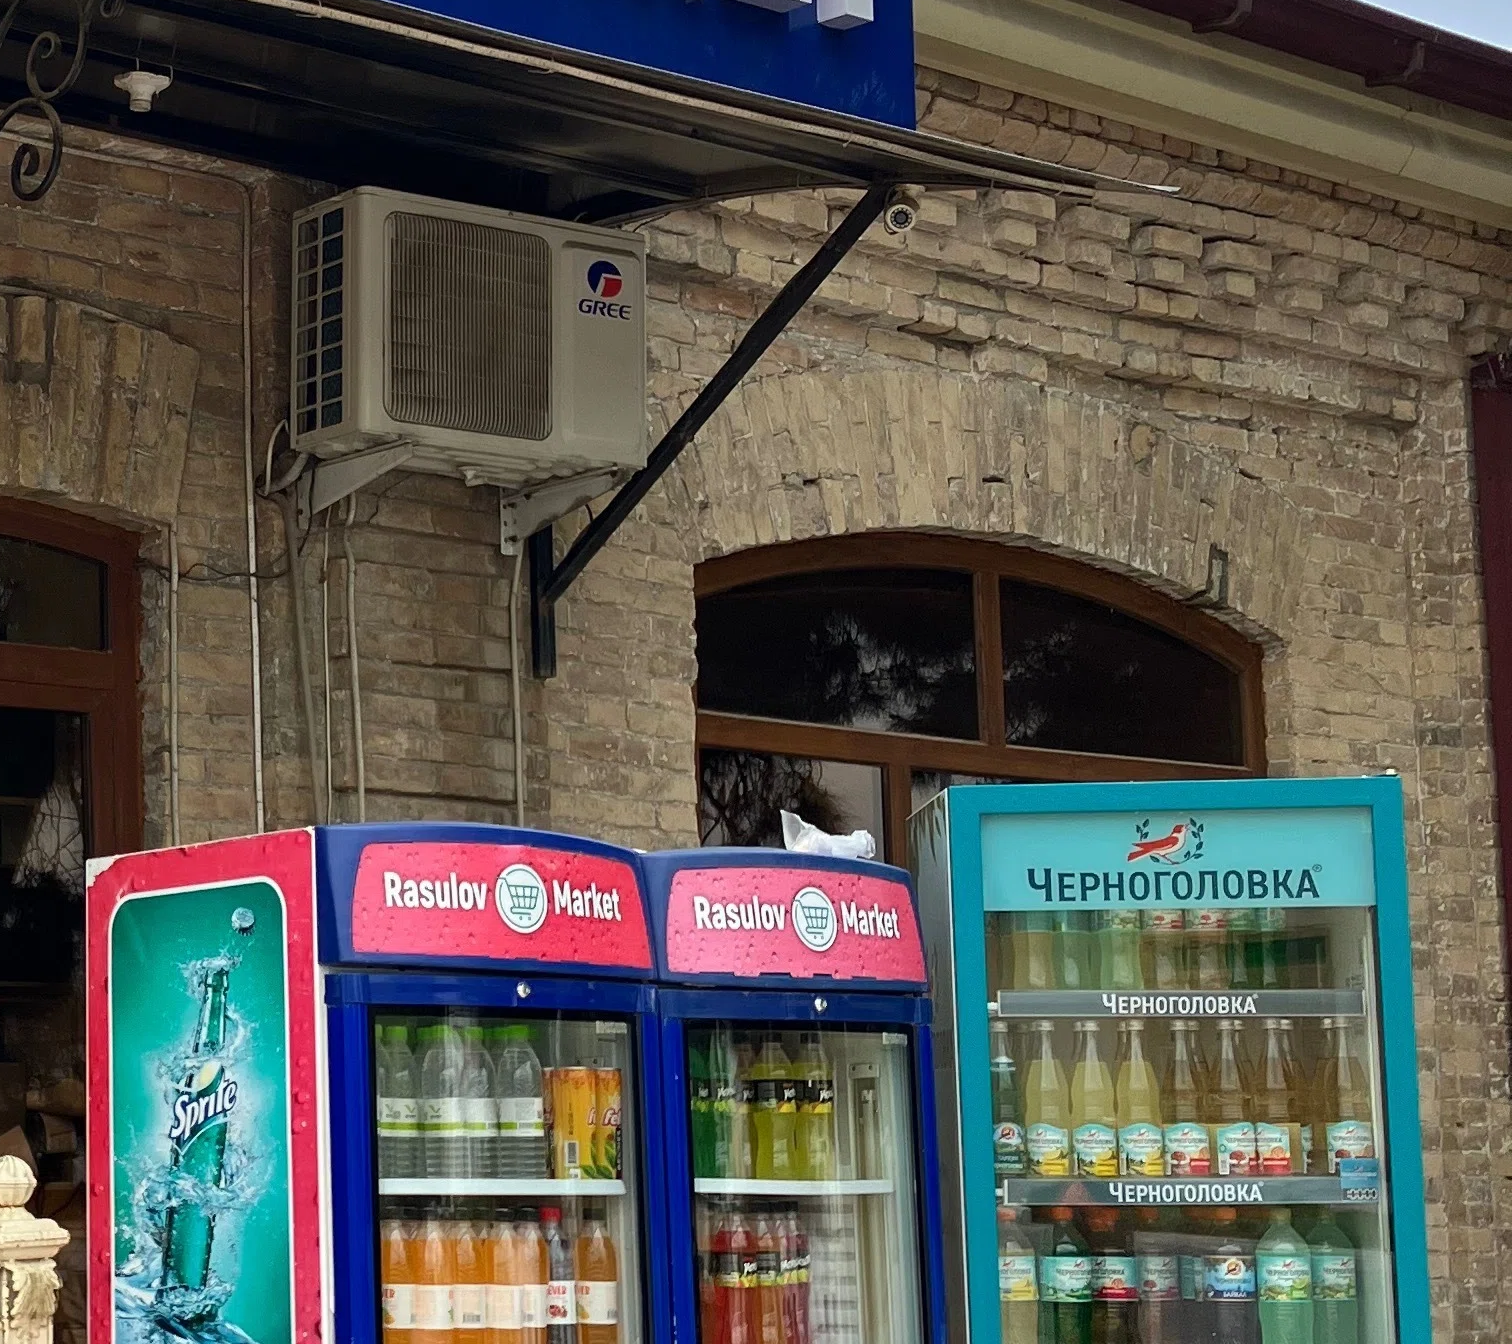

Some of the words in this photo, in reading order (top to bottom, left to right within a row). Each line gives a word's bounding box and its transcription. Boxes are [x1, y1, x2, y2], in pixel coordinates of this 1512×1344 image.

[578, 299, 632, 320] GREE
[383, 871, 488, 912] Rasulov
[552, 879, 623, 922] Market
[694, 894, 787, 931] Rasulov
[841, 900, 901, 940] Market
[169, 1076, 239, 1141] Sprite
